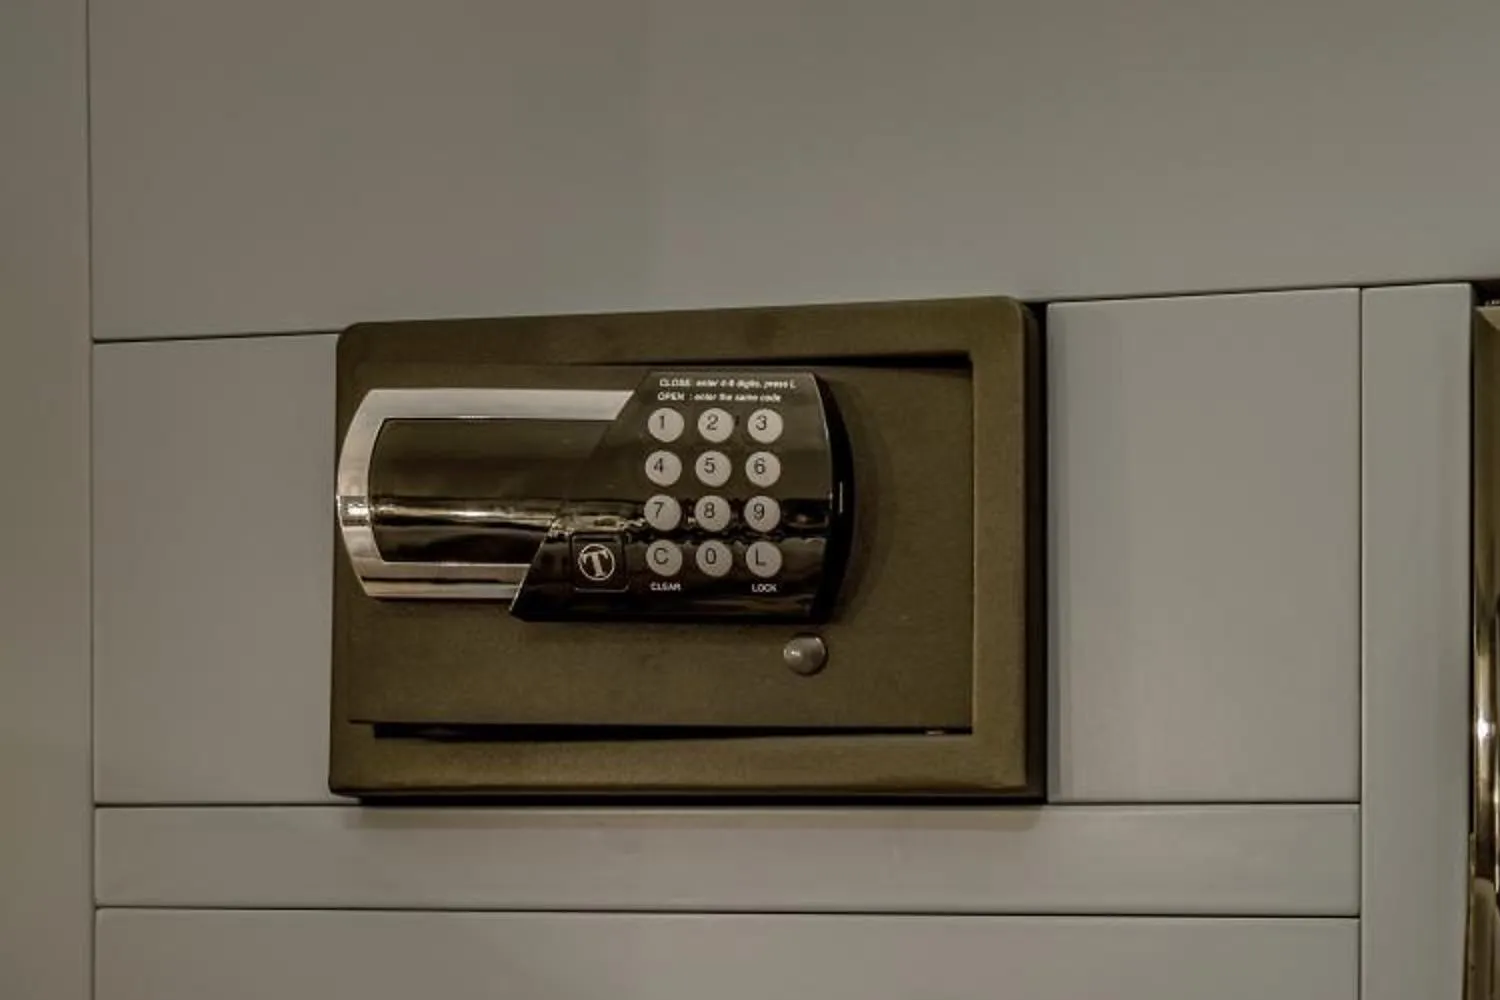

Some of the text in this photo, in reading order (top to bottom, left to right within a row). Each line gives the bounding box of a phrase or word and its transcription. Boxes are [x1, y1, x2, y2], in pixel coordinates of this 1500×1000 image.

[706, 414, 719, 431] 2
[755, 414, 767, 431] 3
[653, 457, 664, 473] 4
[703, 457, 716, 474] 5
[753, 457, 766, 475] 6
[653, 502, 665, 519] 7
[703, 501, 716, 519] 8
[753, 503, 765, 520] 9
[653, 547, 669, 565] C
[754, 548, 767, 566] L
[650, 581, 682, 592] CLEAR
[751, 583, 777, 593] LOCK
